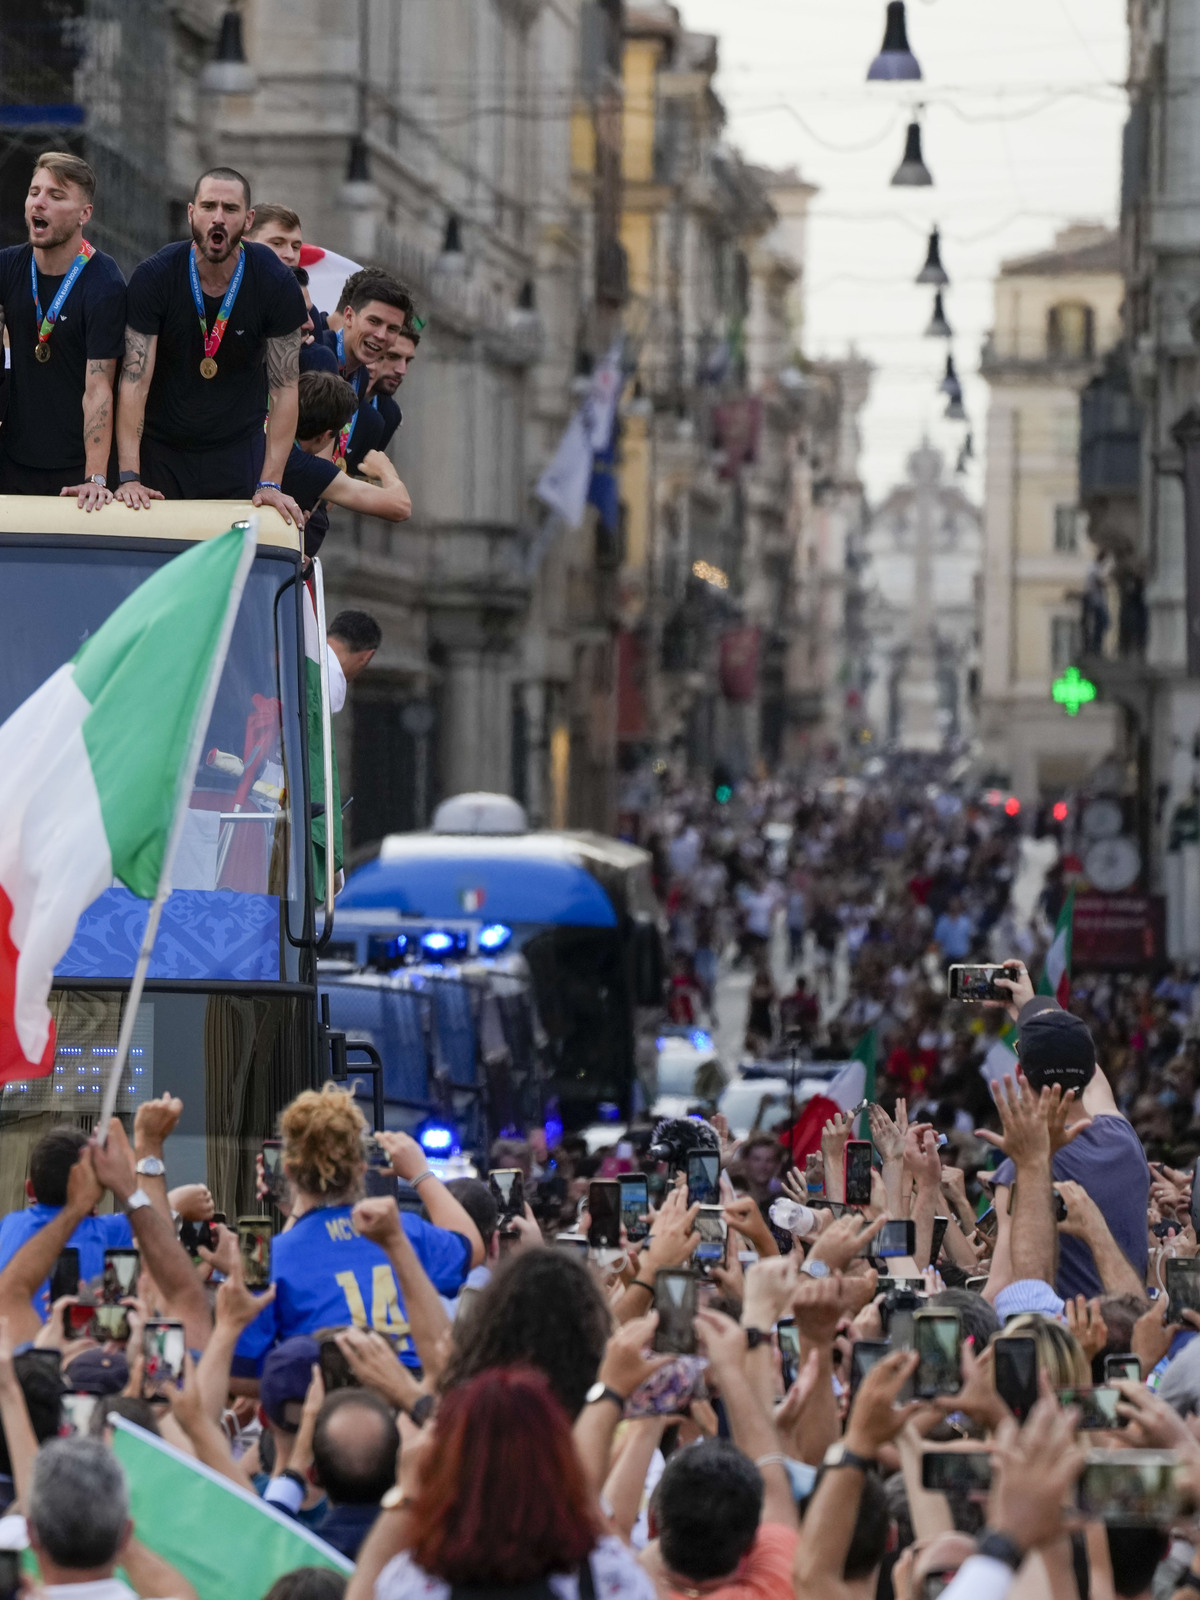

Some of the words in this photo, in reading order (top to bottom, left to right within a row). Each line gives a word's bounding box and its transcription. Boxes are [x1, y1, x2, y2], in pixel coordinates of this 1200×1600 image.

[53, 294, 64, 309] UEFA
[62, 280, 72, 296] EURO
[68, 266, 79, 281] 2020
[334, 1263, 411, 1350] 14
